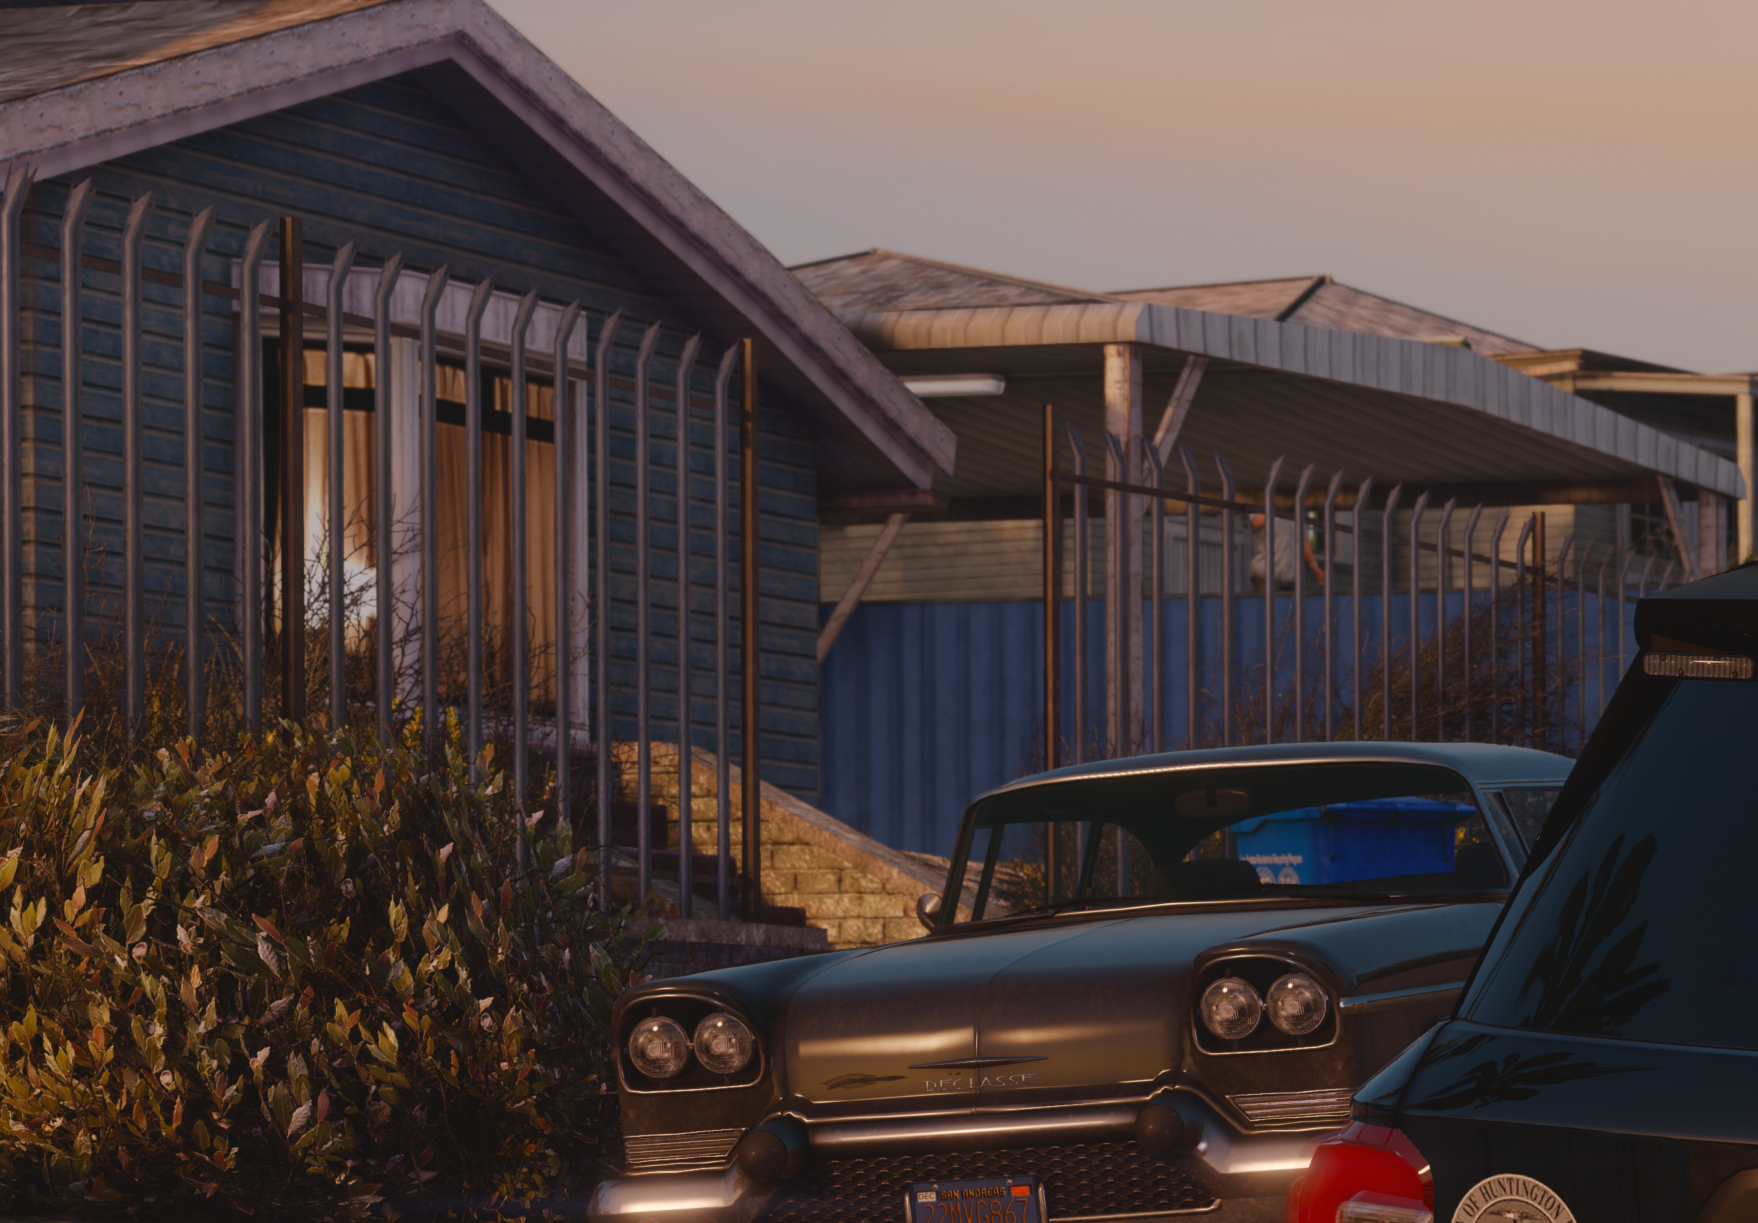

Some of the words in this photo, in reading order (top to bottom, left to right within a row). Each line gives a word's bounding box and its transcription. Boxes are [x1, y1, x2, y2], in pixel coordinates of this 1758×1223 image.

[922, 1073, 1036, 1092] DECLASSE
[918, 1192, 935, 1200] DEC
[940, 1190, 960, 1201] SAN
[962, 1187, 1006, 1199] ANDREAS
[1462, 1194, 1480, 1218] OF
[1479, 1178, 1565, 1219] HUNTINGTON
